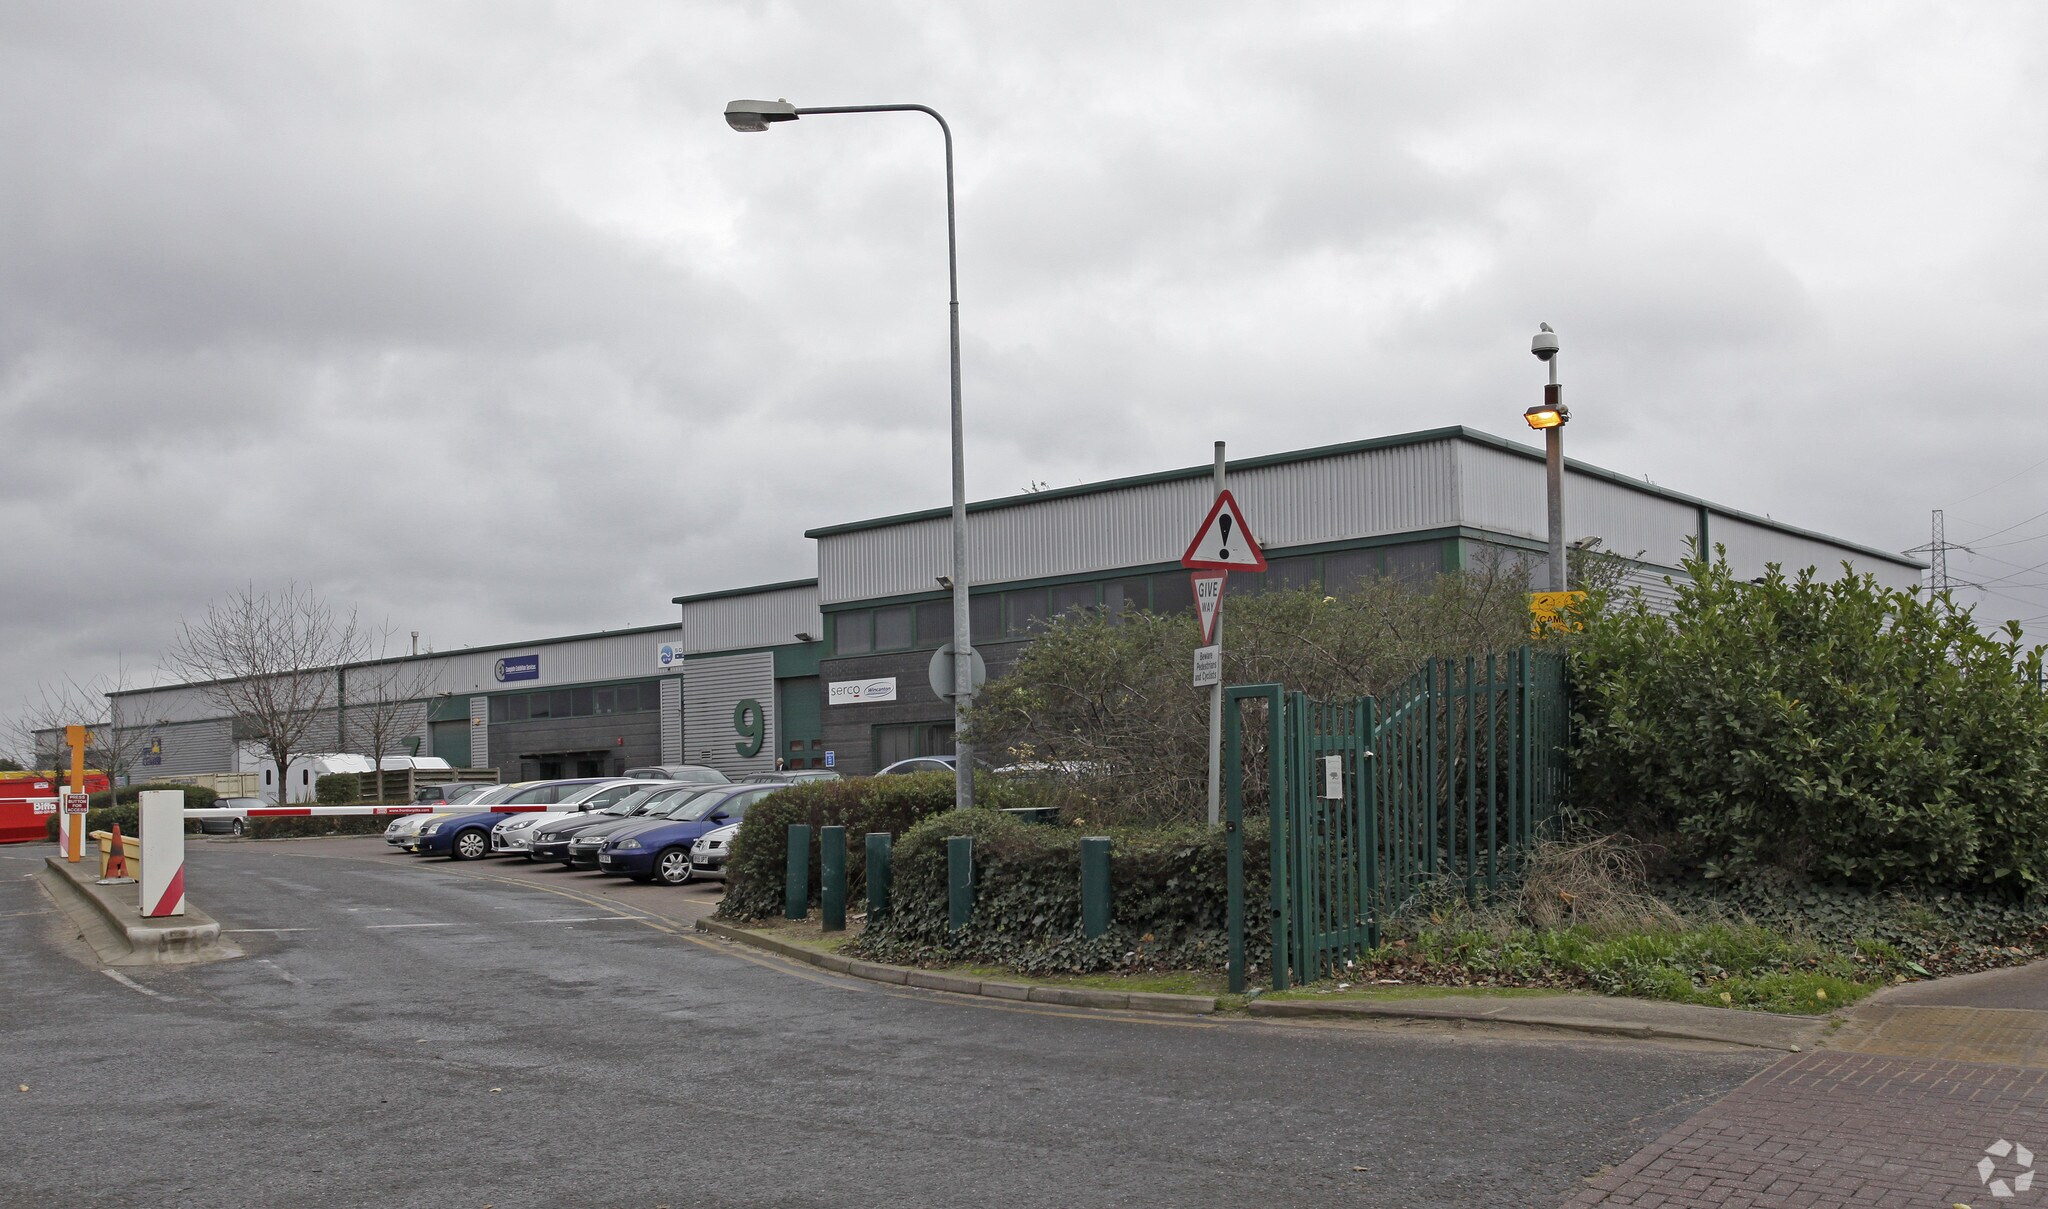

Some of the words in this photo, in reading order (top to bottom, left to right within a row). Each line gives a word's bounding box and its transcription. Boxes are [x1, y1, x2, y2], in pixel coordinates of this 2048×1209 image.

[1199, 581, 1218, 598] GIVE
[1202, 601, 1215, 613] WAY
[1199, 652, 1213, 661] Beware
[1196, 661, 1217, 671] Pedestrians
[1202, 671, 1217, 682] Cyclists
[830, 685, 861, 697] serco
[734, 699, 764, 758] 9
[33, 802, 57, 811] Biffa
